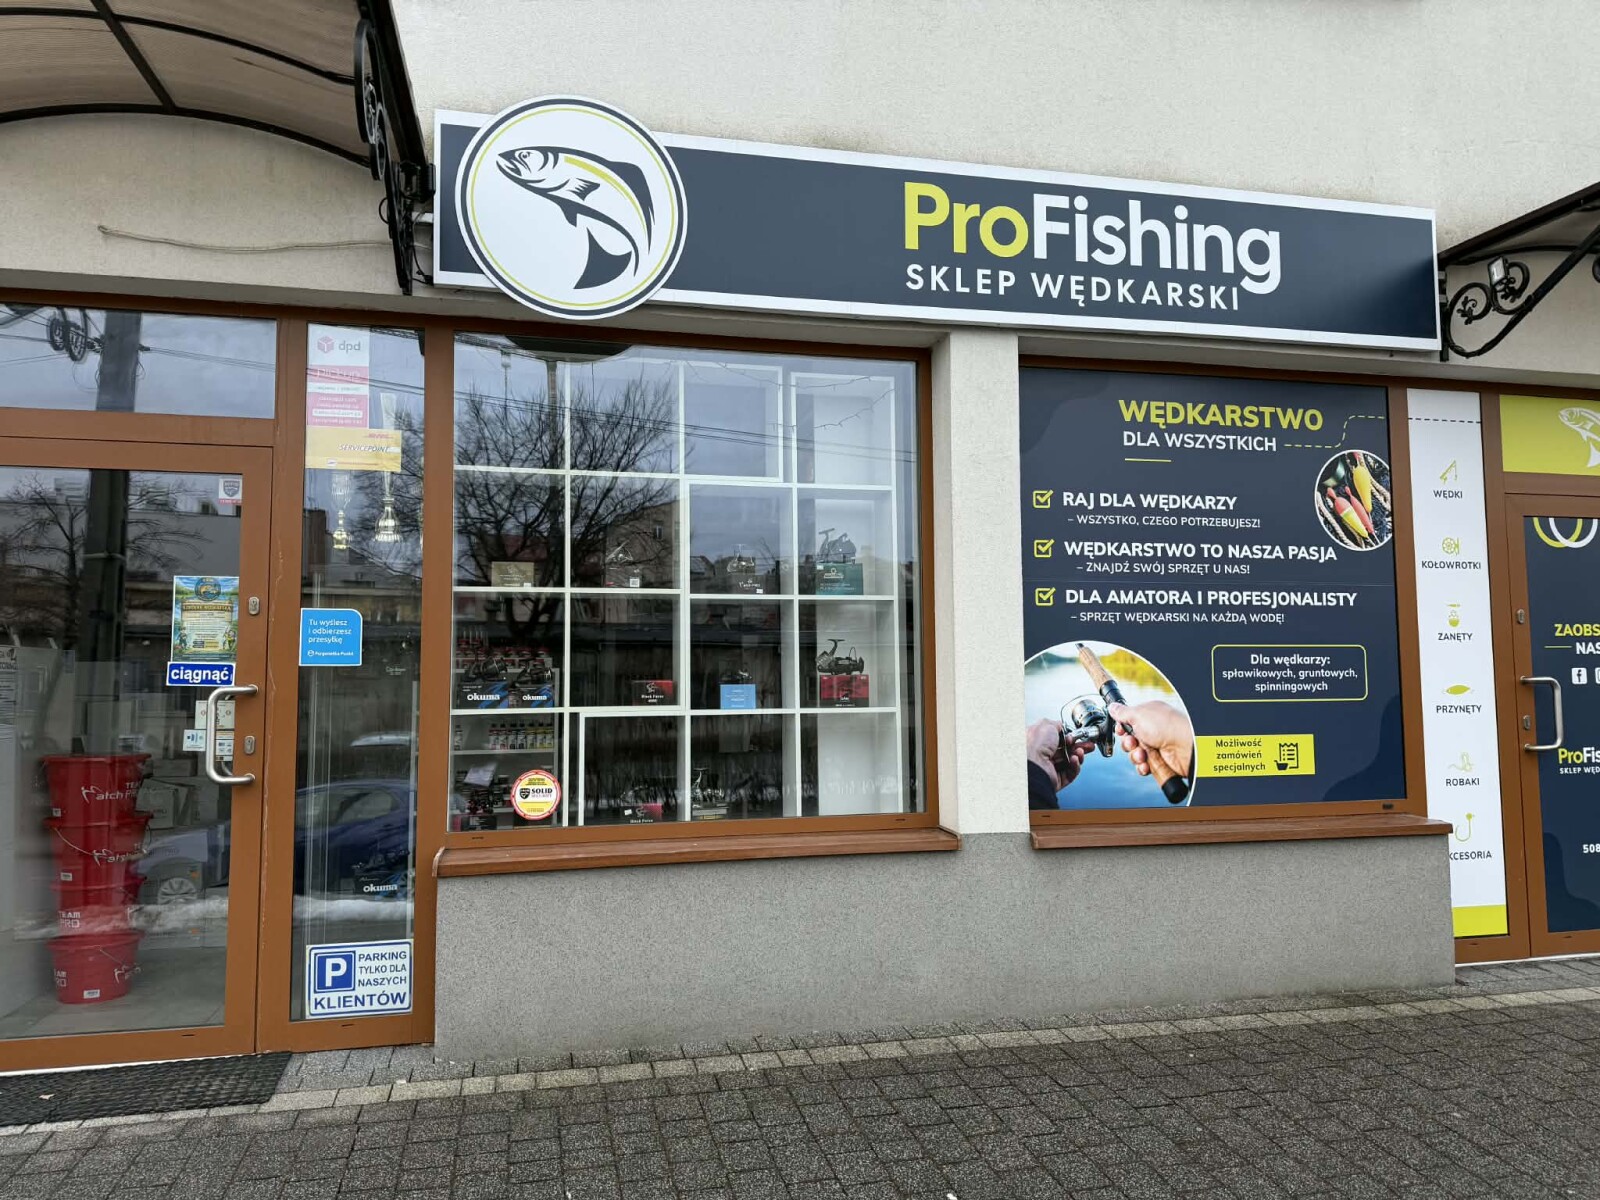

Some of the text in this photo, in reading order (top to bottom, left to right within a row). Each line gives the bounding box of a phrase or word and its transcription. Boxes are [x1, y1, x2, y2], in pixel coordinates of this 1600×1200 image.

[904, 181, 1281, 294] ProFishing
[905, 263, 1239, 311] SKLEP WĘDKARSKI
[338, 340, 361, 354] dpd
[1118, 399, 1324, 431] WĘDKARSTWO
[1123, 430, 1277, 452] DLA WSZYSTKICH
[1433, 489, 1463, 500] WĘDKI
[1063, 491, 1238, 511] RAJ DLA WĘDKARZY
[1076, 515, 1140, 527] WSZYSTKO,
[1142, 516, 1178, 526] CZEGO
[1180, 517, 1261, 529] POTRZEBUJESZ!
[1064, 541, 1338, 563] WĘDKARSTWO TO NASZA PASJA
[1086, 559, 1130, 574] ZNAJDŹ
[1133, 560, 1165, 575] SWÓJ
[1168, 563, 1209, 576] SPRZĘT
[1213, 564, 1221, 574] U
[1224, 564, 1250, 574] NAS!
[1421, 560, 1482, 570] KOŁOWROTKI
[1065, 589, 1357, 608] DLA AMATORA I PROFESJONALISTY
[309, 618, 318, 626] Tu
[1079, 611, 1122, 623] SPRZĘT
[1124, 612, 1190, 624] WĘDKARSKI
[1192, 612, 1208, 622] NA
[1211, 610, 1247, 625] KAŻDĄ
[1249, 612, 1284, 624] WODĘ!
[312, 627, 352, 635] odbierzesz
[1554, 623, 1600, 637] ZAOBS
[308, 635, 343, 645] przesyłkę
[1437, 632, 1473, 642] ZANĘTY
[1575, 641, 1600, 655] NAS
[1250, 654, 1331, 667] Dla wędkarzy:
[170, 666, 229, 684] ciągnąć
[1222, 668, 1358, 680] spławikowych, gruntowych,
[1254, 681, 1328, 693] spinningowych
[466, 692, 501, 701] okuma
[522, 693, 548, 701] okuma
[1436, 704, 1482, 715] PRZYNĘTY
[1215, 738, 1263, 748] Możliwość
[1216, 750, 1262, 759] zamówień
[1558, 746, 1600, 764] ProFis
[1213, 761, 1266, 774] specjalnych
[1560, 767, 1582, 775] SKLEP
[1445, 777, 1480, 787] ROBAKI
[1583, 843, 1600, 854] 508
[1450, 851, 1492, 861] KCESORIA
[363, 883, 398, 893] okuma
[358, 951, 407, 962] PARKING
[325, 957, 347, 987] P
[358, 964, 407, 975] TYLKO DLA
[358, 976, 407, 987] NASZYCH
[314, 990, 407, 1010] KLIENTÓW
